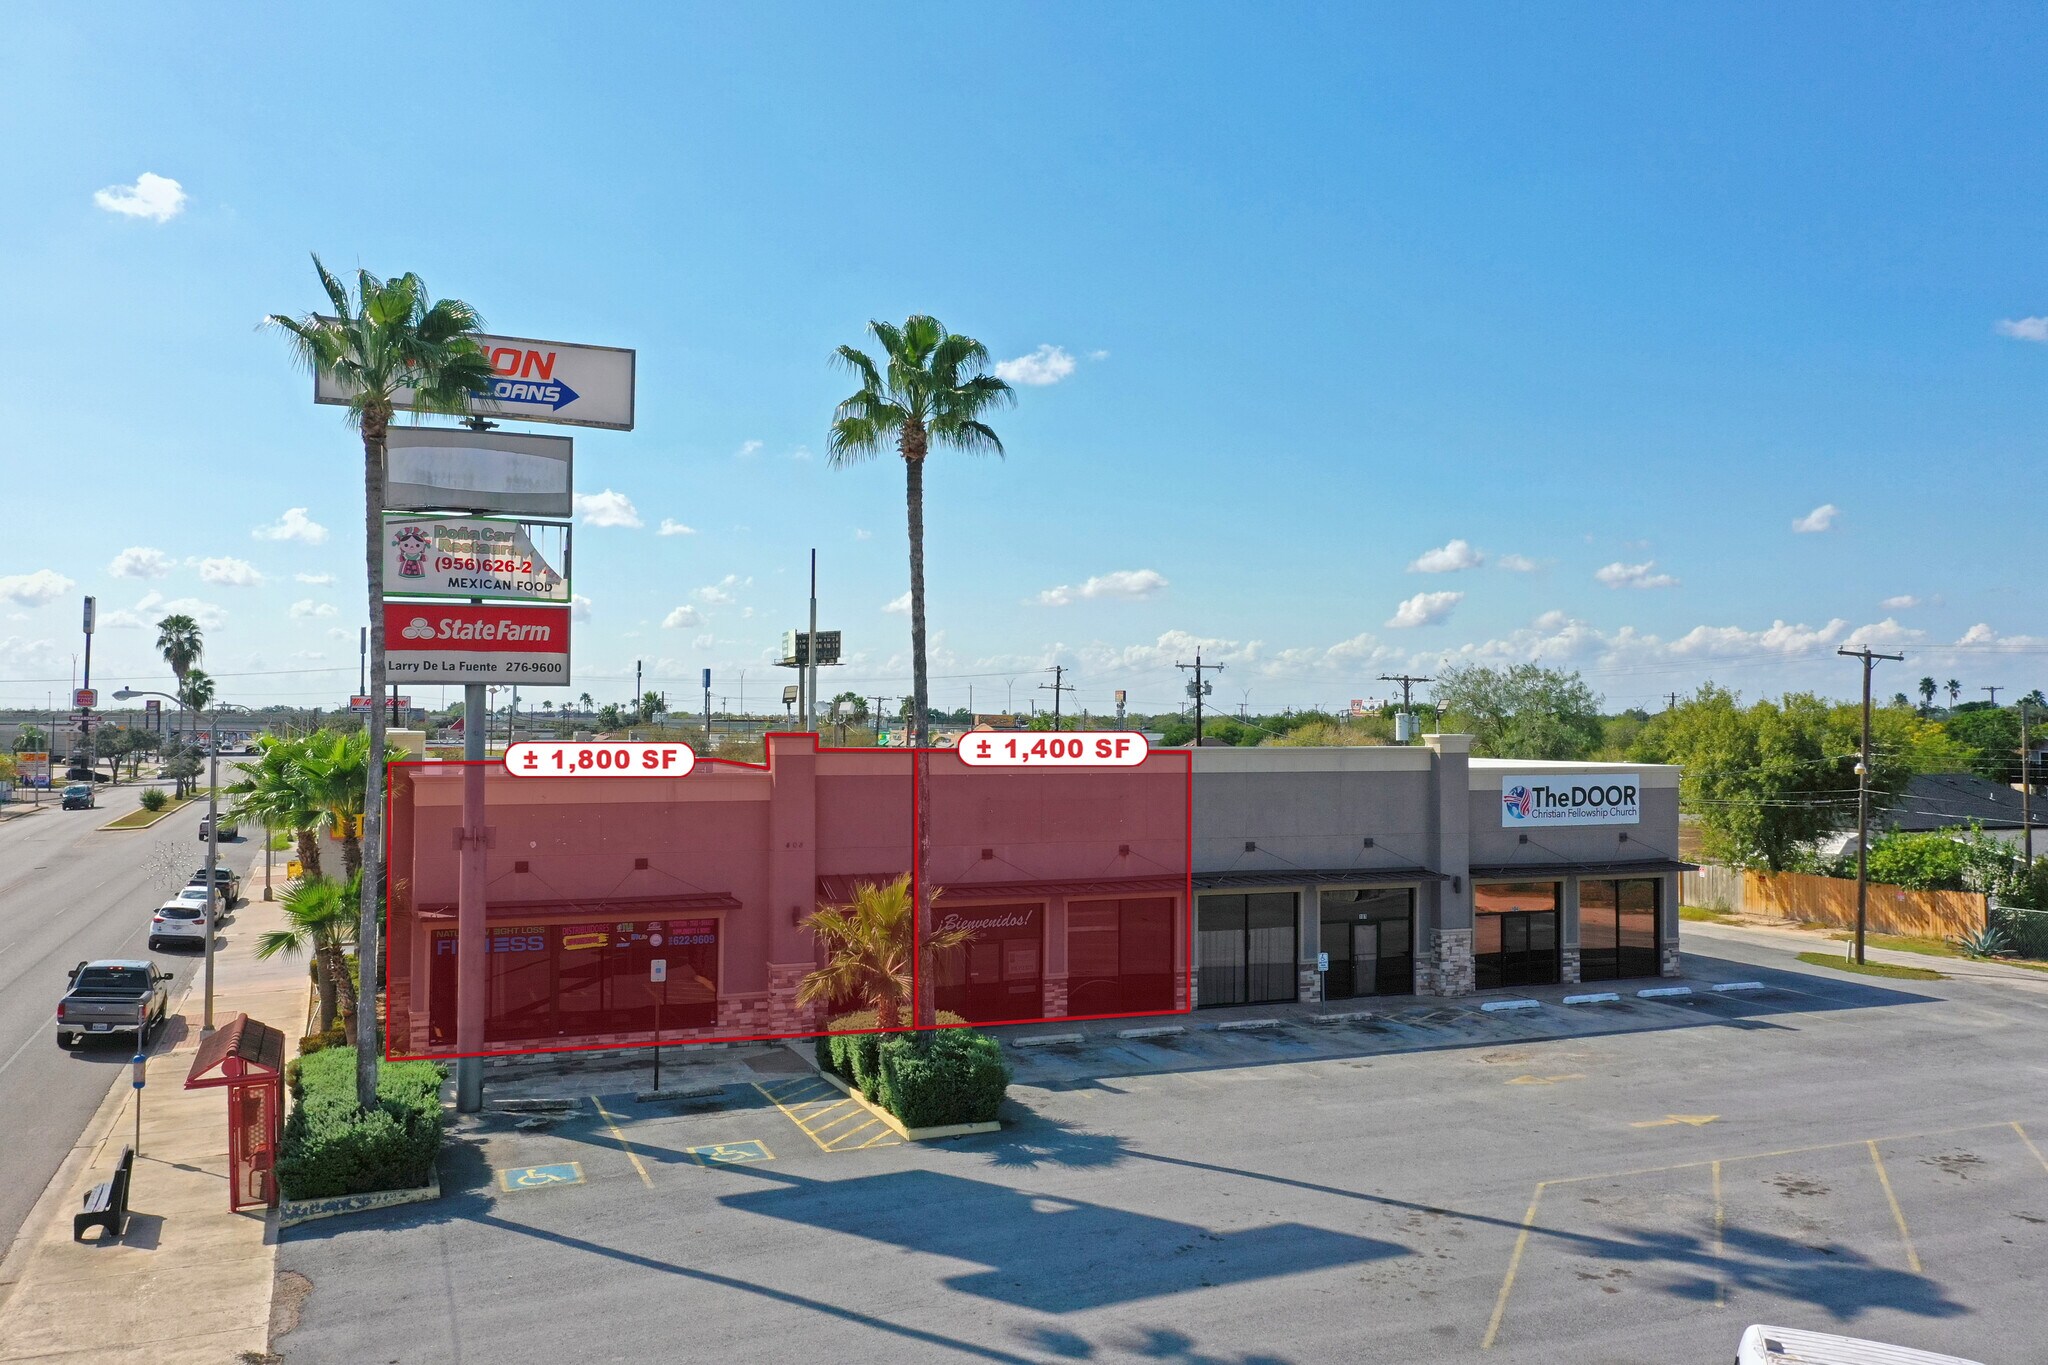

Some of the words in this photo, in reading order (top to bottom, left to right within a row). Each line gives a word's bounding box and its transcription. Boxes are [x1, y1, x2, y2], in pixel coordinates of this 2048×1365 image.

[482, 382, 561, 402] OANS
[447, 577, 511, 591] MEXICAN
[517, 581, 553, 593] FOOD
[388, 660, 420, 672] Larry
[423, 661, 438, 671] De
[442, 661, 455, 671] La
[459, 661, 497, 672] Fuente
[505, 662, 562, 673] 276-9600
[1531, 809, 1566, 819] Christian
[1567, 807, 1608, 818] Fellowship
[1609, 806, 1637, 816] Church
[521, 926, 545, 934] LOSS
[673, 934, 715, 945] 622-9609
